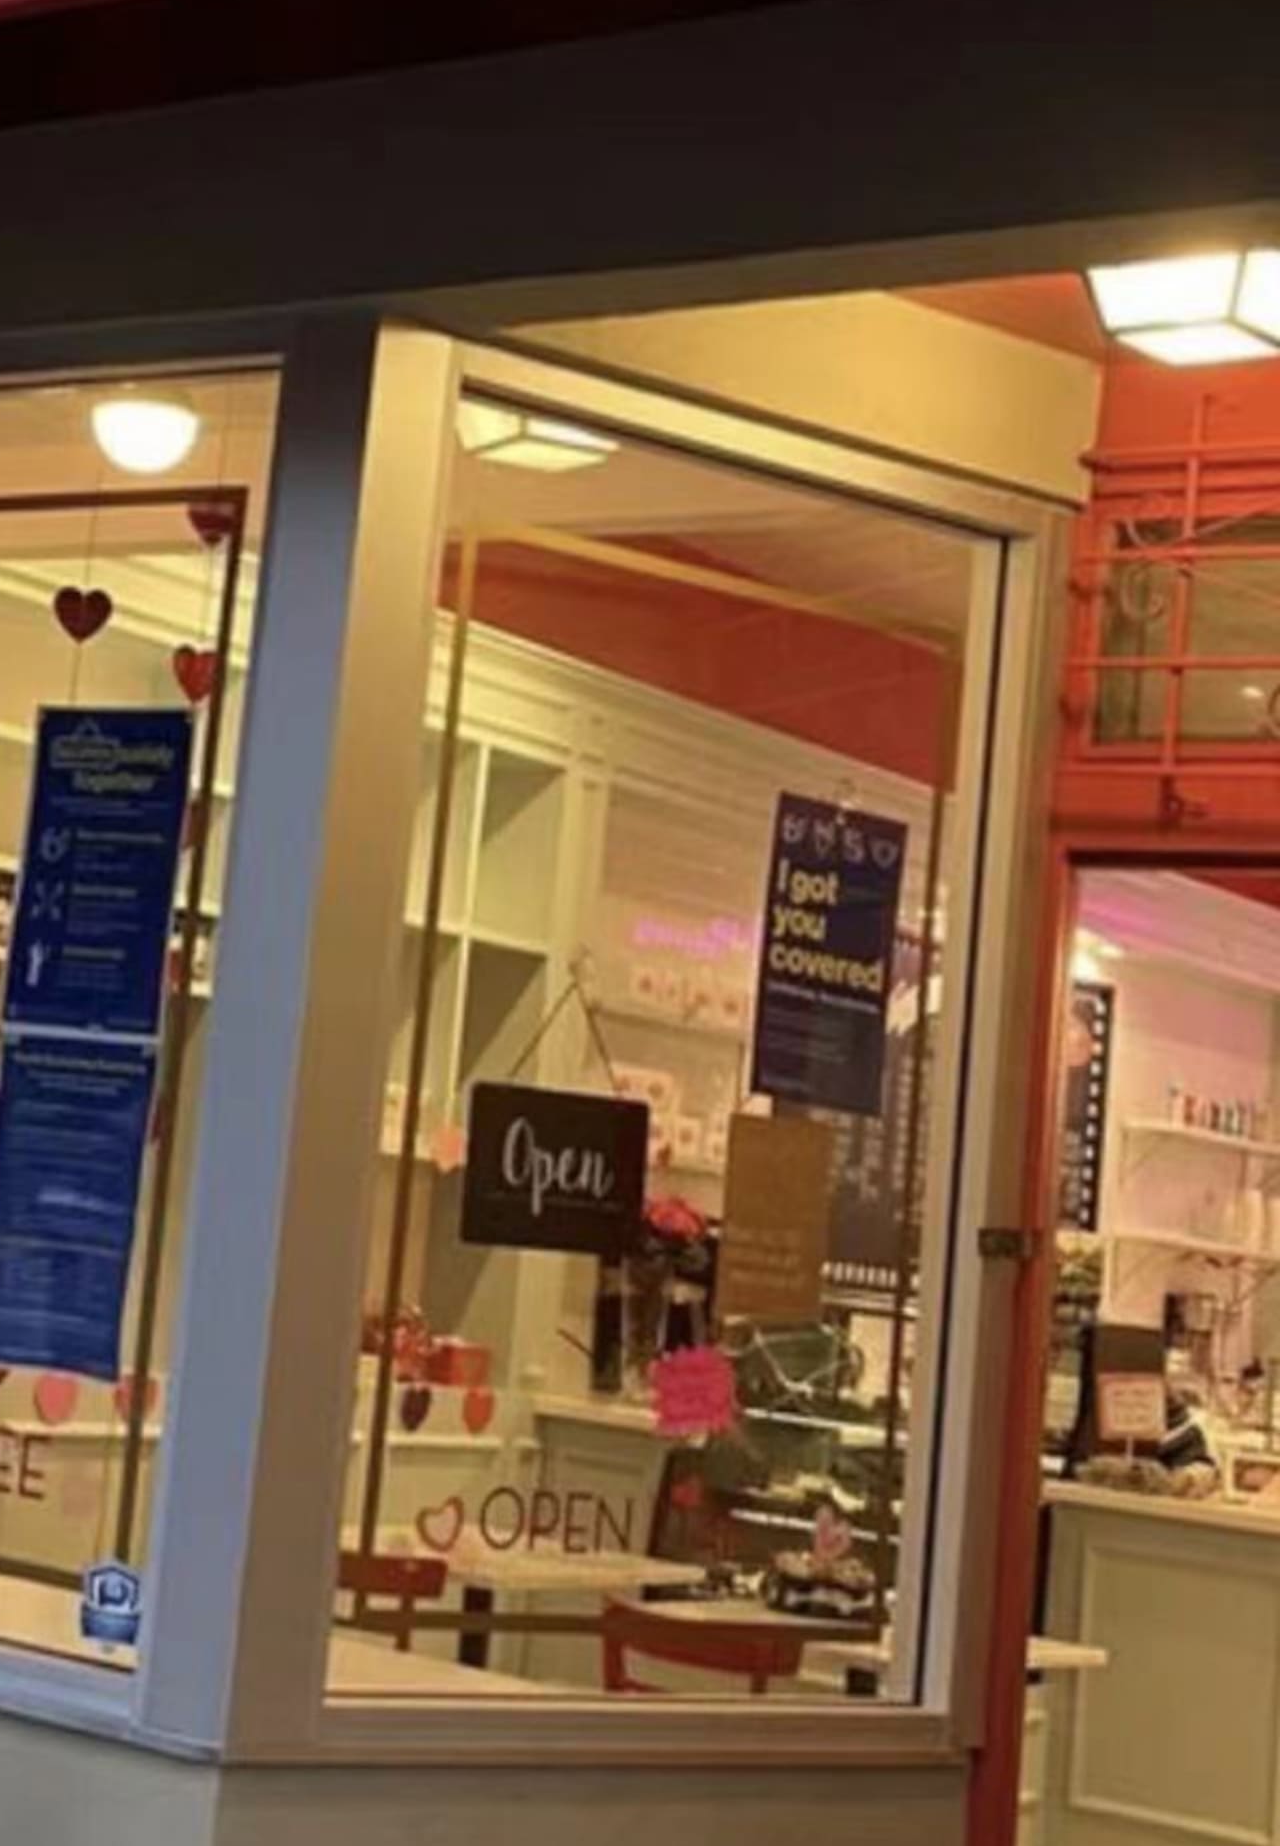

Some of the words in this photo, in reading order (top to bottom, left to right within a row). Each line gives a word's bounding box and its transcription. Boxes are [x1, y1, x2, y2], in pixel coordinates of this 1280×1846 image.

[777, 858, 790, 893] I
[789, 870, 840, 904] got
[772, 906, 827, 940] you
[769, 945, 883, 993] covered
[501, 1116, 616, 1217] Open
[479, 1485, 635, 1555] OPEN
